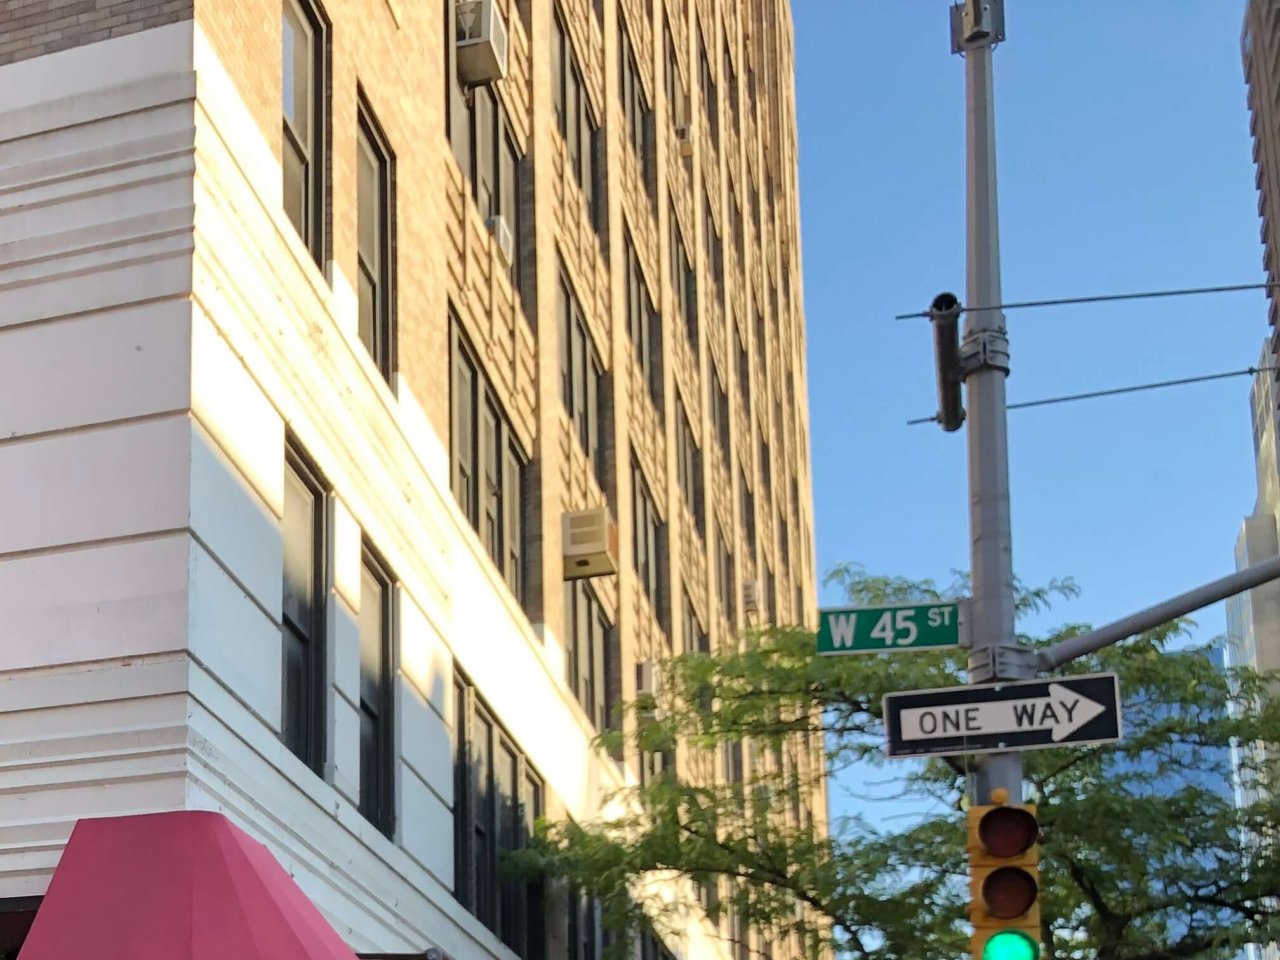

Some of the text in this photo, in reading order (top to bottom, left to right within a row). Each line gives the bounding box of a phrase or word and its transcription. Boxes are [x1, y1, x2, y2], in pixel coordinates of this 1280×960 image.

[828, 606, 954, 648] W 45 ST
[919, 699, 1080, 735] ONE WAY
